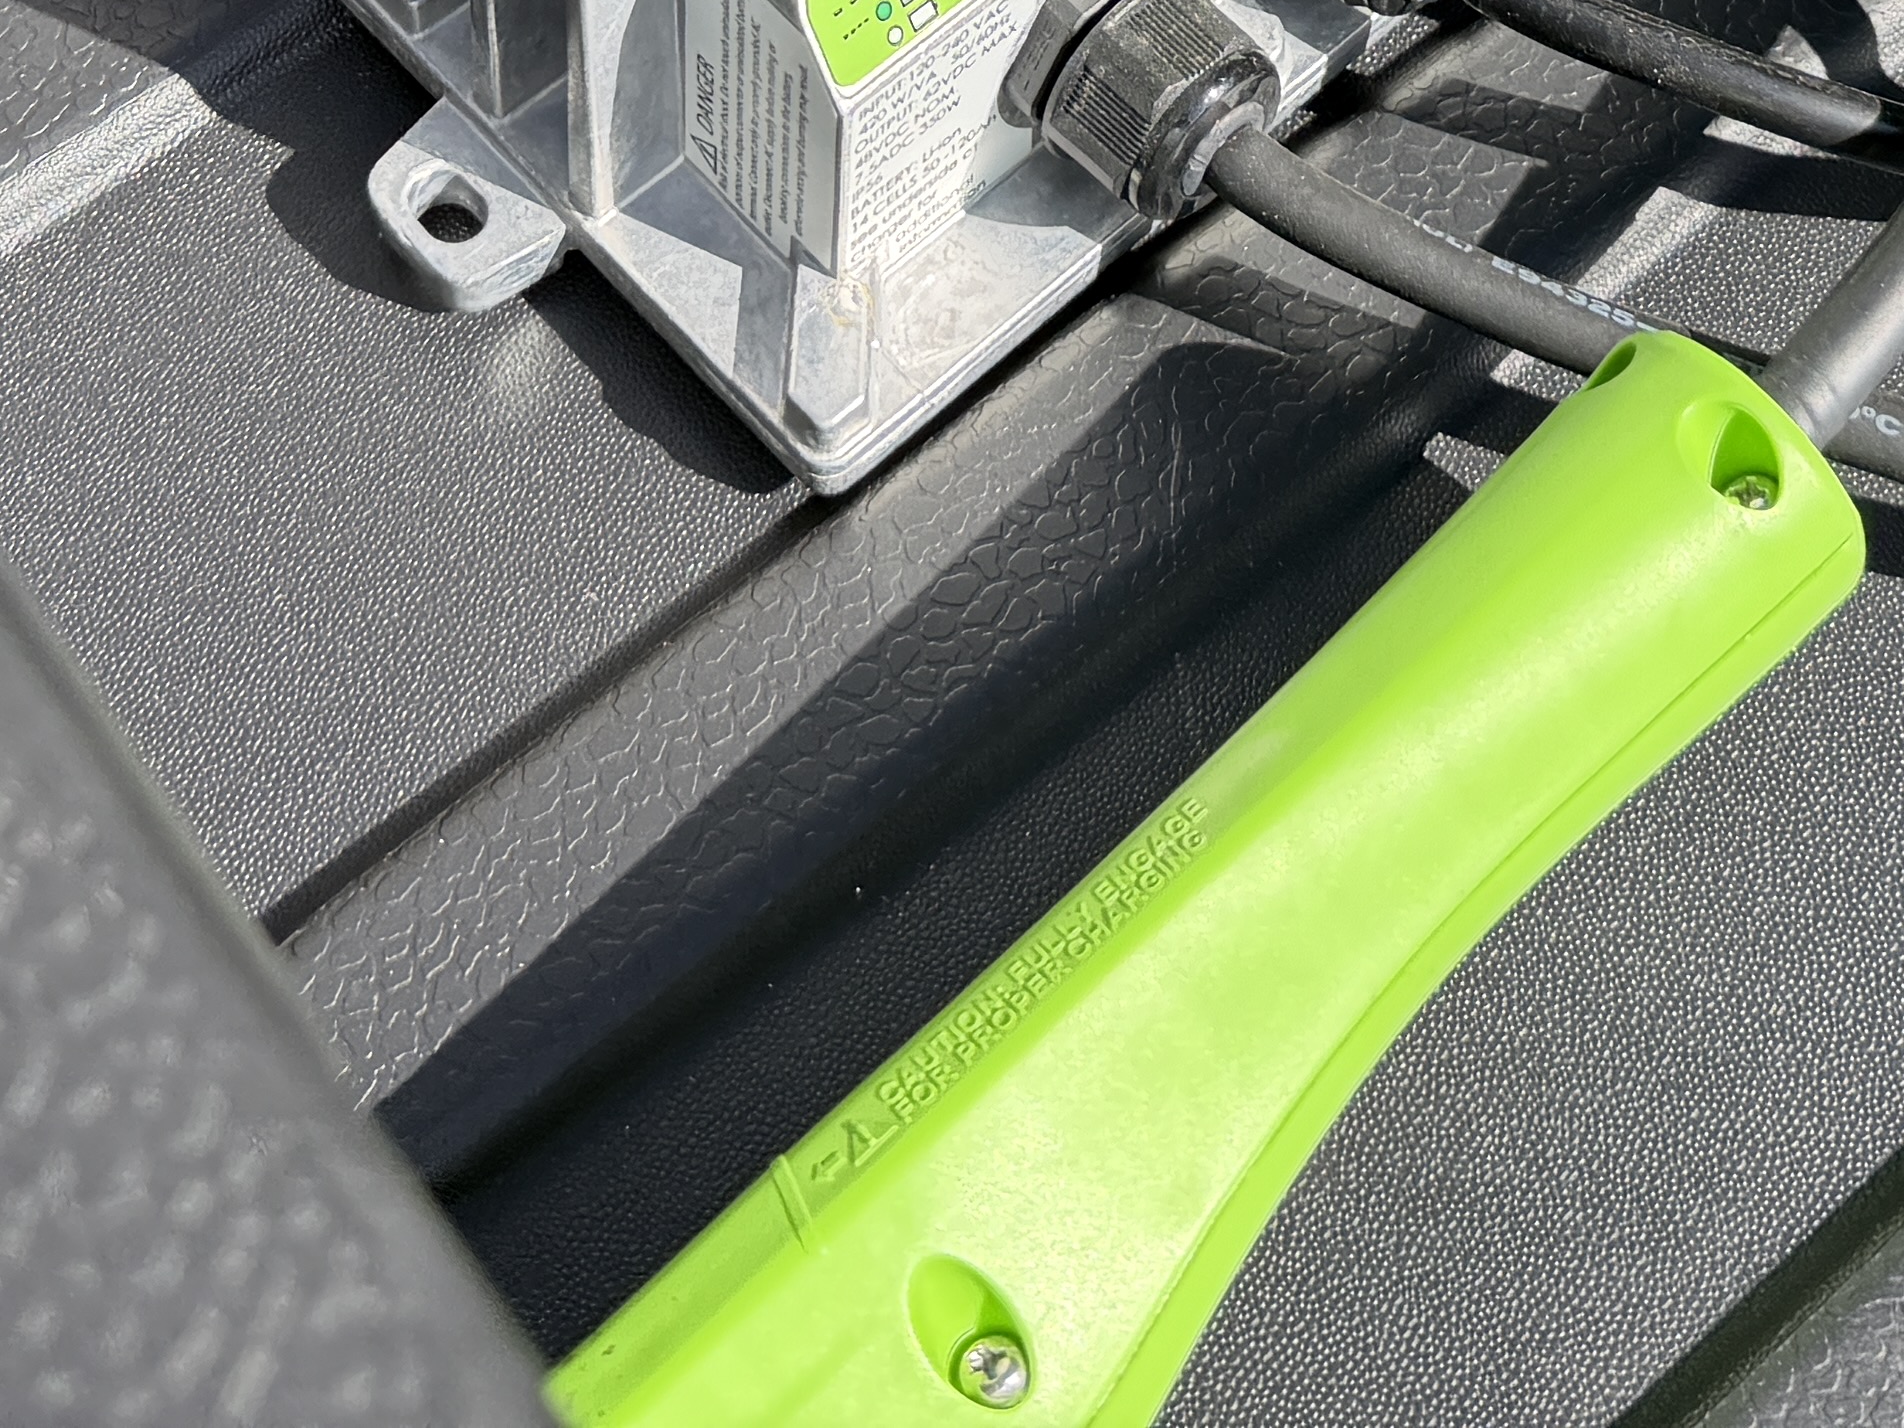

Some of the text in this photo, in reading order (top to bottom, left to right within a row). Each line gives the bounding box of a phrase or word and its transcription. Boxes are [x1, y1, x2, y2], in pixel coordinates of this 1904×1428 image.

[981, 20, 1016, 57] MAX
[696, 50, 713, 138] DANGER
[873, 173, 916, 218] CELLS
[1008, 901, 1095, 984] FULLY
[1094, 797, 1210, 906] ENGAGE
[892, 827, 1210, 1124] FOR PROPER CHARGING
